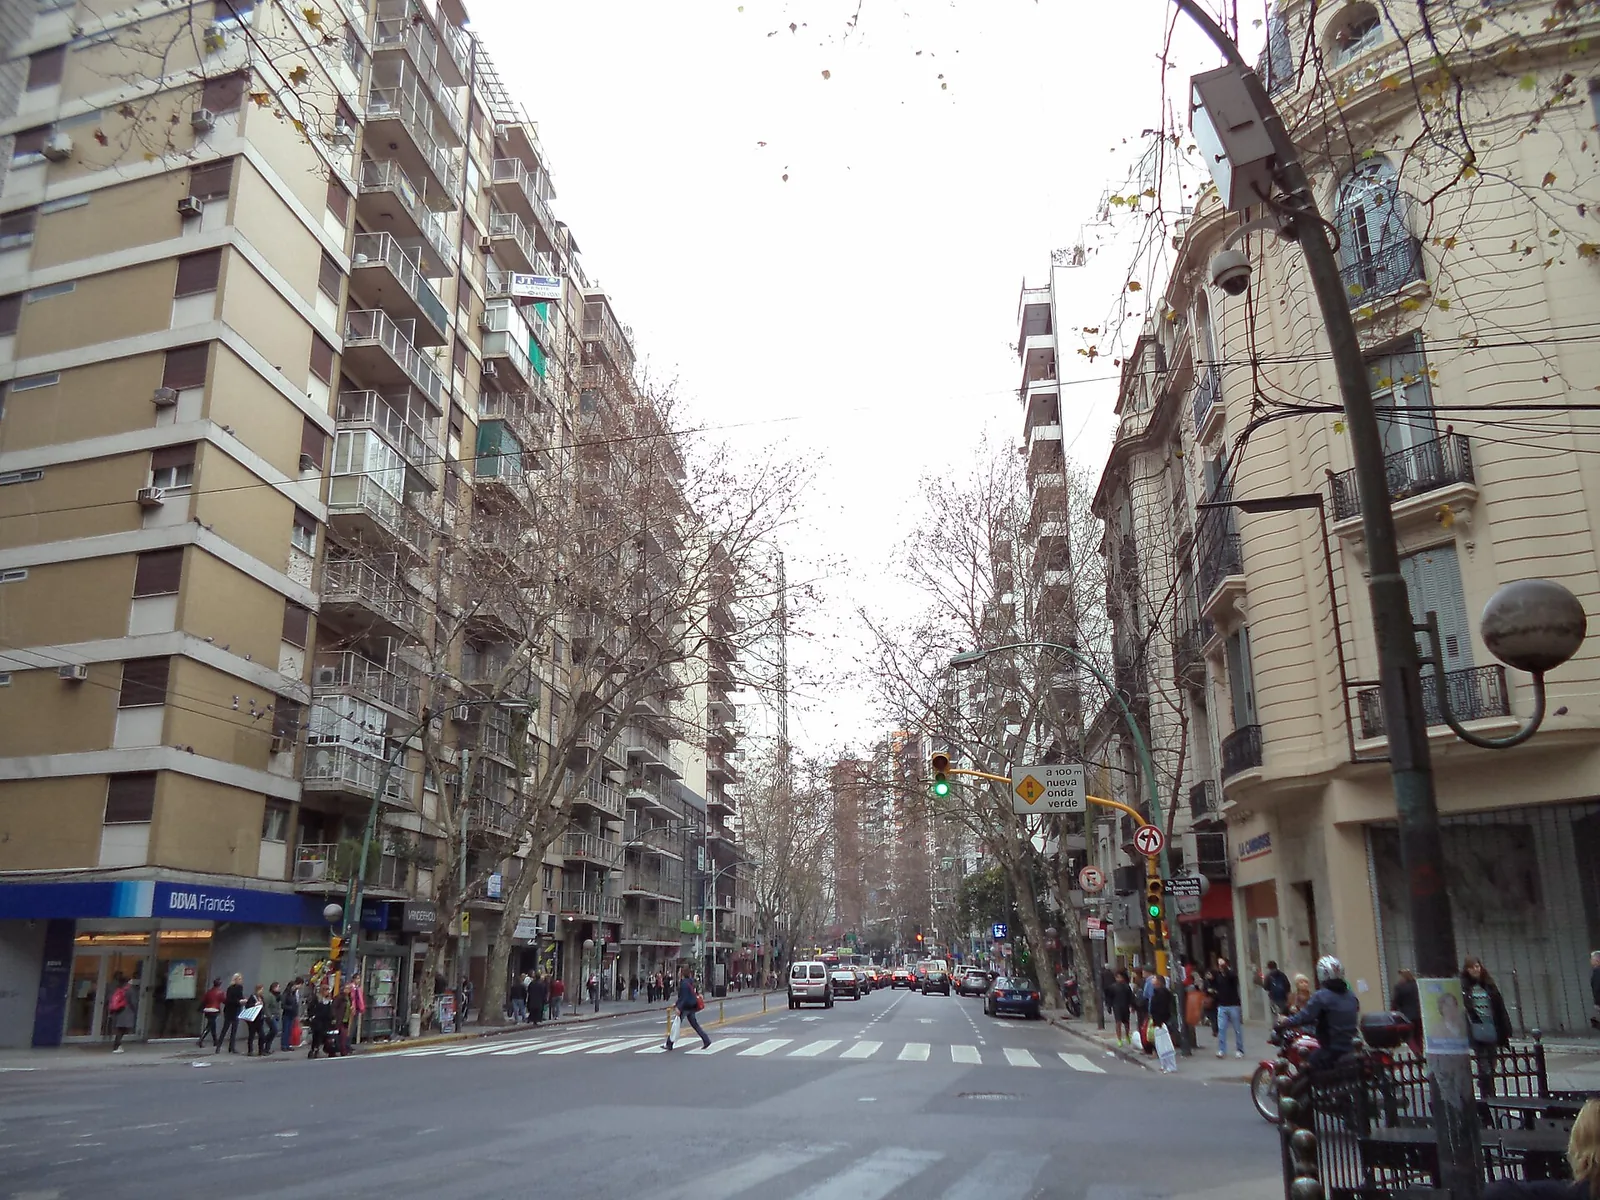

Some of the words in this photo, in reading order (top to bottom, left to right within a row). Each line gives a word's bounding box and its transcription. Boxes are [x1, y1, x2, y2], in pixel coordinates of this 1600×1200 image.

[1046, 779, 1077, 787] nueva
[1047, 788, 1074, 797] onda
[1048, 798, 1078, 808] verde
[169, 892, 198, 910] BBVA
[198, 894, 235, 912] Francés
